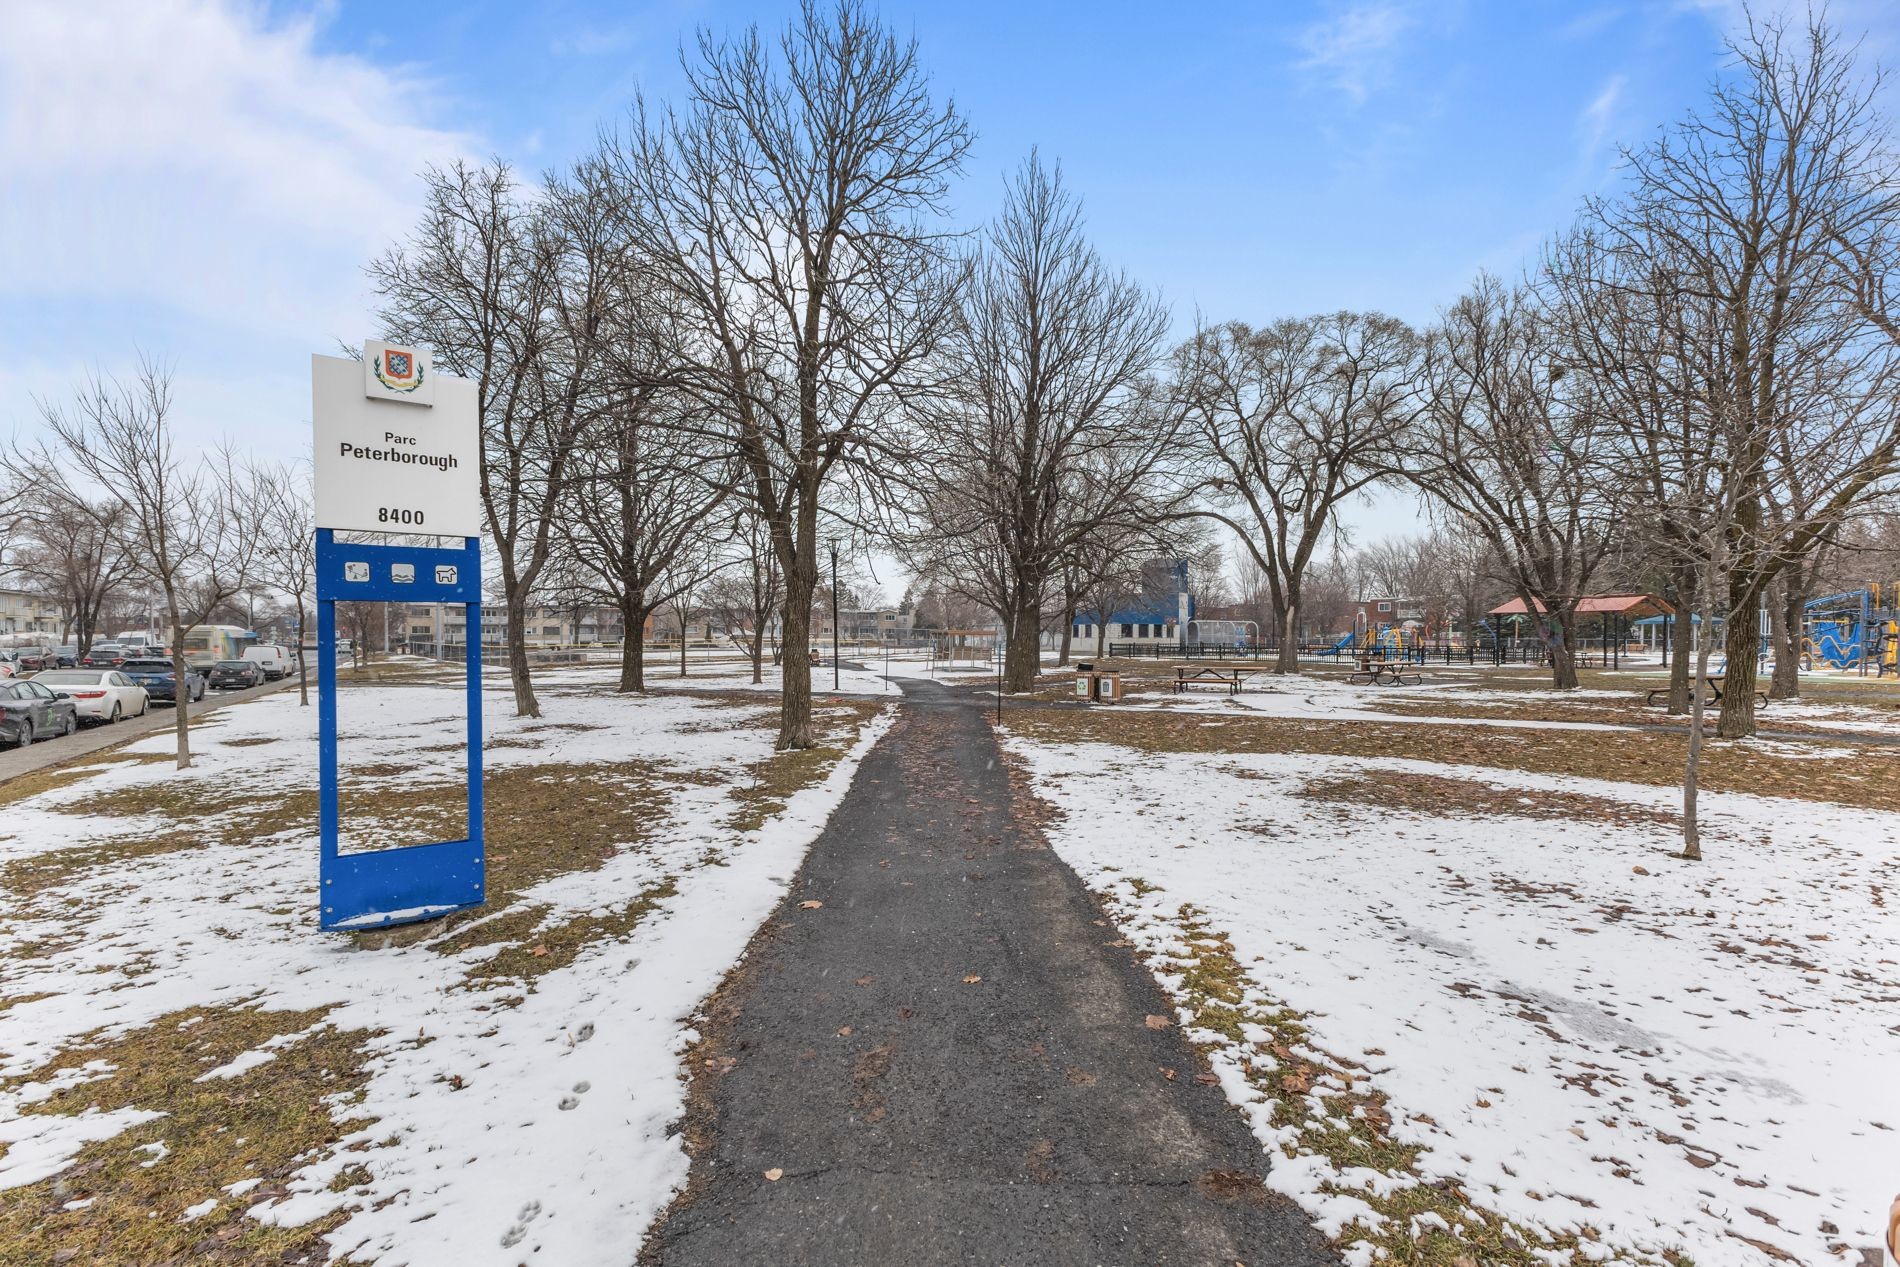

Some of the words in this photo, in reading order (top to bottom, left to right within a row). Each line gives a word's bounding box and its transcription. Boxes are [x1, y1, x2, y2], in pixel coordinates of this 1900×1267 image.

[384, 431, 417, 446] Parc
[340, 442, 459, 471] Peterborough
[378, 507, 425, 525] 8400
